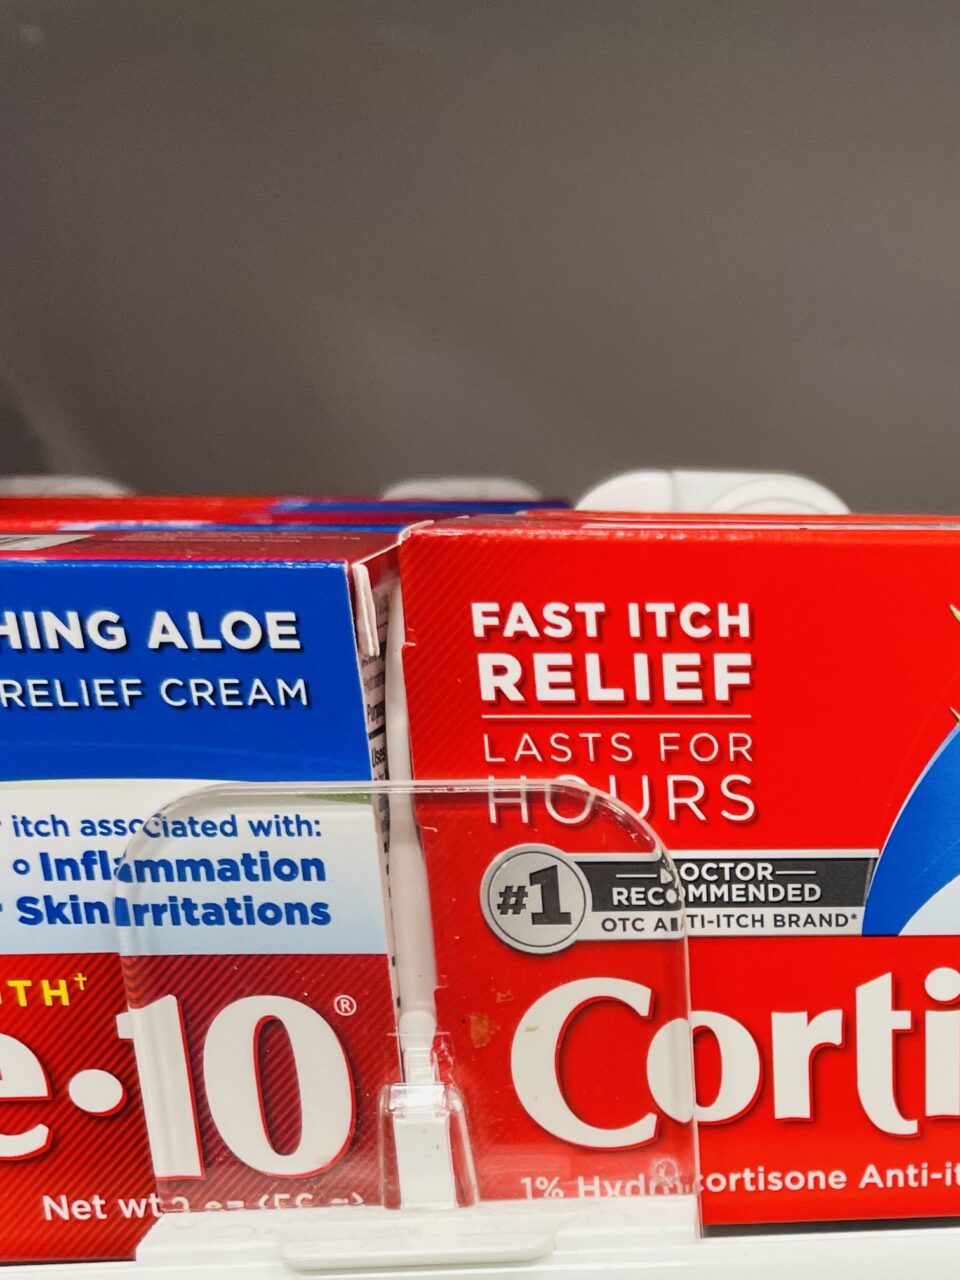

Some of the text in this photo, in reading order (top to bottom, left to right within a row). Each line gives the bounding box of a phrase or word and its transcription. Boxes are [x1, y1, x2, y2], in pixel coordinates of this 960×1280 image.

[147, 611, 302, 650] ALOE
[471, 602, 751, 639] FAST ITCH
[0, 677, 309, 708] RELIEF CREAM
[477, 652, 753, 702] RELIEF
[483, 732, 754, 763] LASTS FOR
[487, 774, 756, 825] HOURS
[13, 814, 70, 838] itch
[247, 814, 322, 838] with:
[40, 851, 326, 883] Inflammation
[496, 864, 572, 926] #1
[16, 896, 332, 927] Skin Irritations
[602, 917, 645, 933] OTC
[42, 1195, 107, 1221] Net
[118, 1194, 163, 1218] wt
